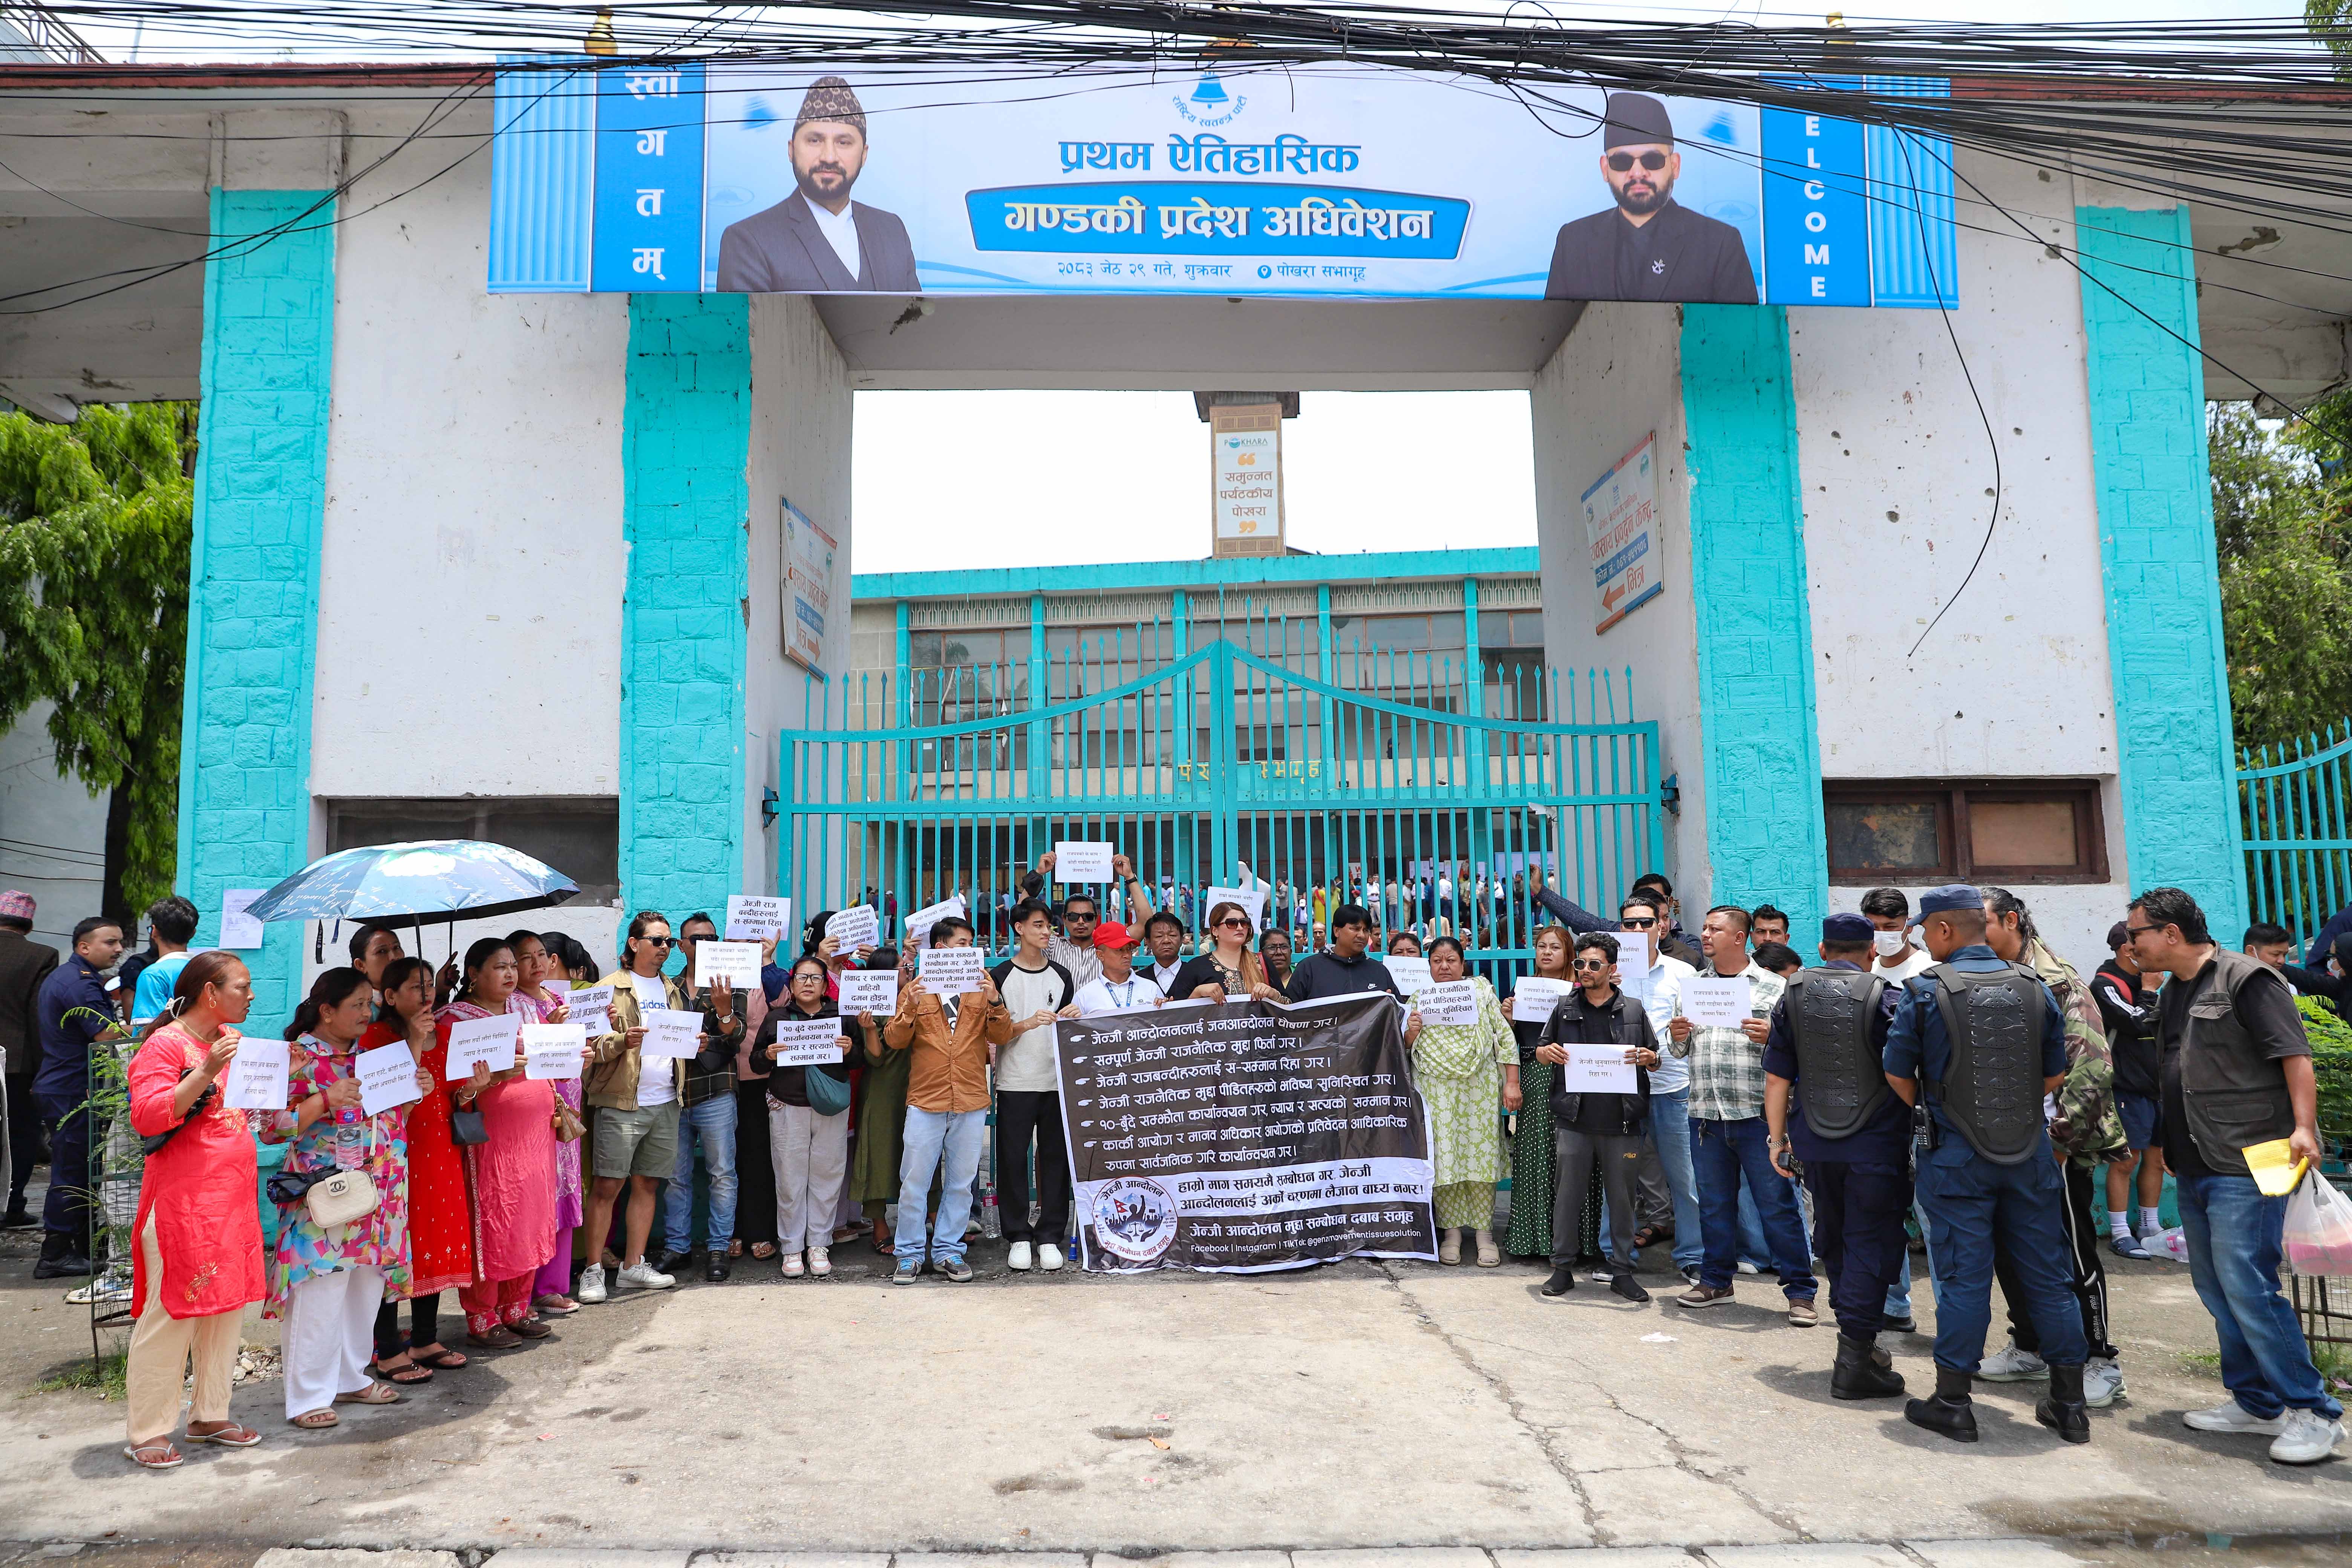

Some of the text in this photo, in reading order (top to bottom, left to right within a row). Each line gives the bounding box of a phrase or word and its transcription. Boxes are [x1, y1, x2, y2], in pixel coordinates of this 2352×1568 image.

[1058, 133, 1361, 175] प्रथम ऐतिहासिक
[1798, 86, 1830, 298] ELCOME
[1004, 195, 1436, 241] गण्डकी प्रदेश अधिवेशन
[1057, 260, 1233, 280] २०८३ जेठ २९ गते, शुक्रवार
[1277, 261, 1367, 283] पोखरा सभागृह
[1224, 471, 1273, 484] समुन्नत
[1219, 486, 1274, 500] पर्यटकीय
[1232, 504, 1266, 517] पोखरा
[742, 899, 761, 908] जेन्जी
[870, 993, 887, 1002] होइन
[1420, 985, 1470, 996] जेन्जी राजनैतिक
[639, 999, 666, 1009] didas
[807, 1022, 836, 1031] सम्झौता
[1091, 1029, 1122, 1045] जेन्जी
[1126, 1018, 1204, 1042] आन्दोलनलाई
[1207, 1014, 1275, 1032] जनआन्दोलन
[808, 1041, 834, 1050] सत्यको
[1093, 1049, 1132, 1067] सम्पूर्ण
[1135, 1046, 1167, 1062] जेन्जी
[1170, 1039, 1227, 1058] राजनैतिक
[1230, 1040, 1250, 1055] मुद्दा
[1254, 1034, 1276, 1050] फिर्ता
[1095, 1073, 1127, 1089] जेन्जी
[1131, 1060, 1222, 1084] राजबन्दीहरुलाई
[1224, 1060, 1277, 1074] स-सम्मान
[1280, 1057, 1300, 1070] रिहा
[1098, 1094, 1130, 1110] जेन्जी
[1133, 1088, 1191, 1106] राजनैतिक
[1194, 1087, 1216, 1101] मुद्दा
[1219, 1078, 1277, 1097] पीडितहरुको
[1279, 1075, 1313, 1092] भविष्य
[1099, 1114, 1136, 1132] १०-बुँदे
[1138, 1109, 1185, 1127] सम्झौता
[1187, 1104, 1247, 1121] कार्यान्वयन
[1270, 1100, 1294, 1114] न्याय
[1297, 1101, 1305, 1112] र
[1307, 1095, 1347, 1110] सत्यको
[1352, 1095, 1391, 1108] सम्मान
[1101, 1114, 1407, 1152] कार्की आयोग र मानव अधिकार आयोगको प्रतिवेदन आधिकारिक
[1104, 1159, 1136, 1172] रुपमा
[1138, 1153, 1193, 1170] सार्वजनिक
[1196, 1149, 1216, 1164] गरि
[1218, 1146, 1276, 1164] कार्यान्वयन
[1100, 1180, 1165, 1201] जेन्जी आन्दोलन
[1178, 1178, 1205, 1193] हाम्रो
[1208, 1179, 1230, 1190] माग
[1233, 1174, 1274, 1191] समयमै
[1276, 1171, 1315, 1187] सम्बोधन
[1339, 1164, 1371, 1178] जेन्जी
[1180, 1193, 1257, 1210] आन्दोलनलाई
[1261, 1190, 1285, 1206] अर्को
[1287, 1189, 1321, 1203] चरणमा
[1325, 1184, 1359, 1198] लैजान
[1362, 1183, 1390, 1195] बाध्य
[1188, 1223, 1222, 1237] जेन्जी
[1225, 1222, 1282, 1237] आन्दोलन
[1283, 1220, 1304, 1234] मुद्दा
[1305, 1213, 1346, 1230] सम्बोधन
[1350, 1211, 1380, 1224] दबाब
[1383, 1210, 1414, 1224] समूह
[1191, 1229, 1421, 1254] Facebook Instagram TikTok: @genzmovementissuesolution
